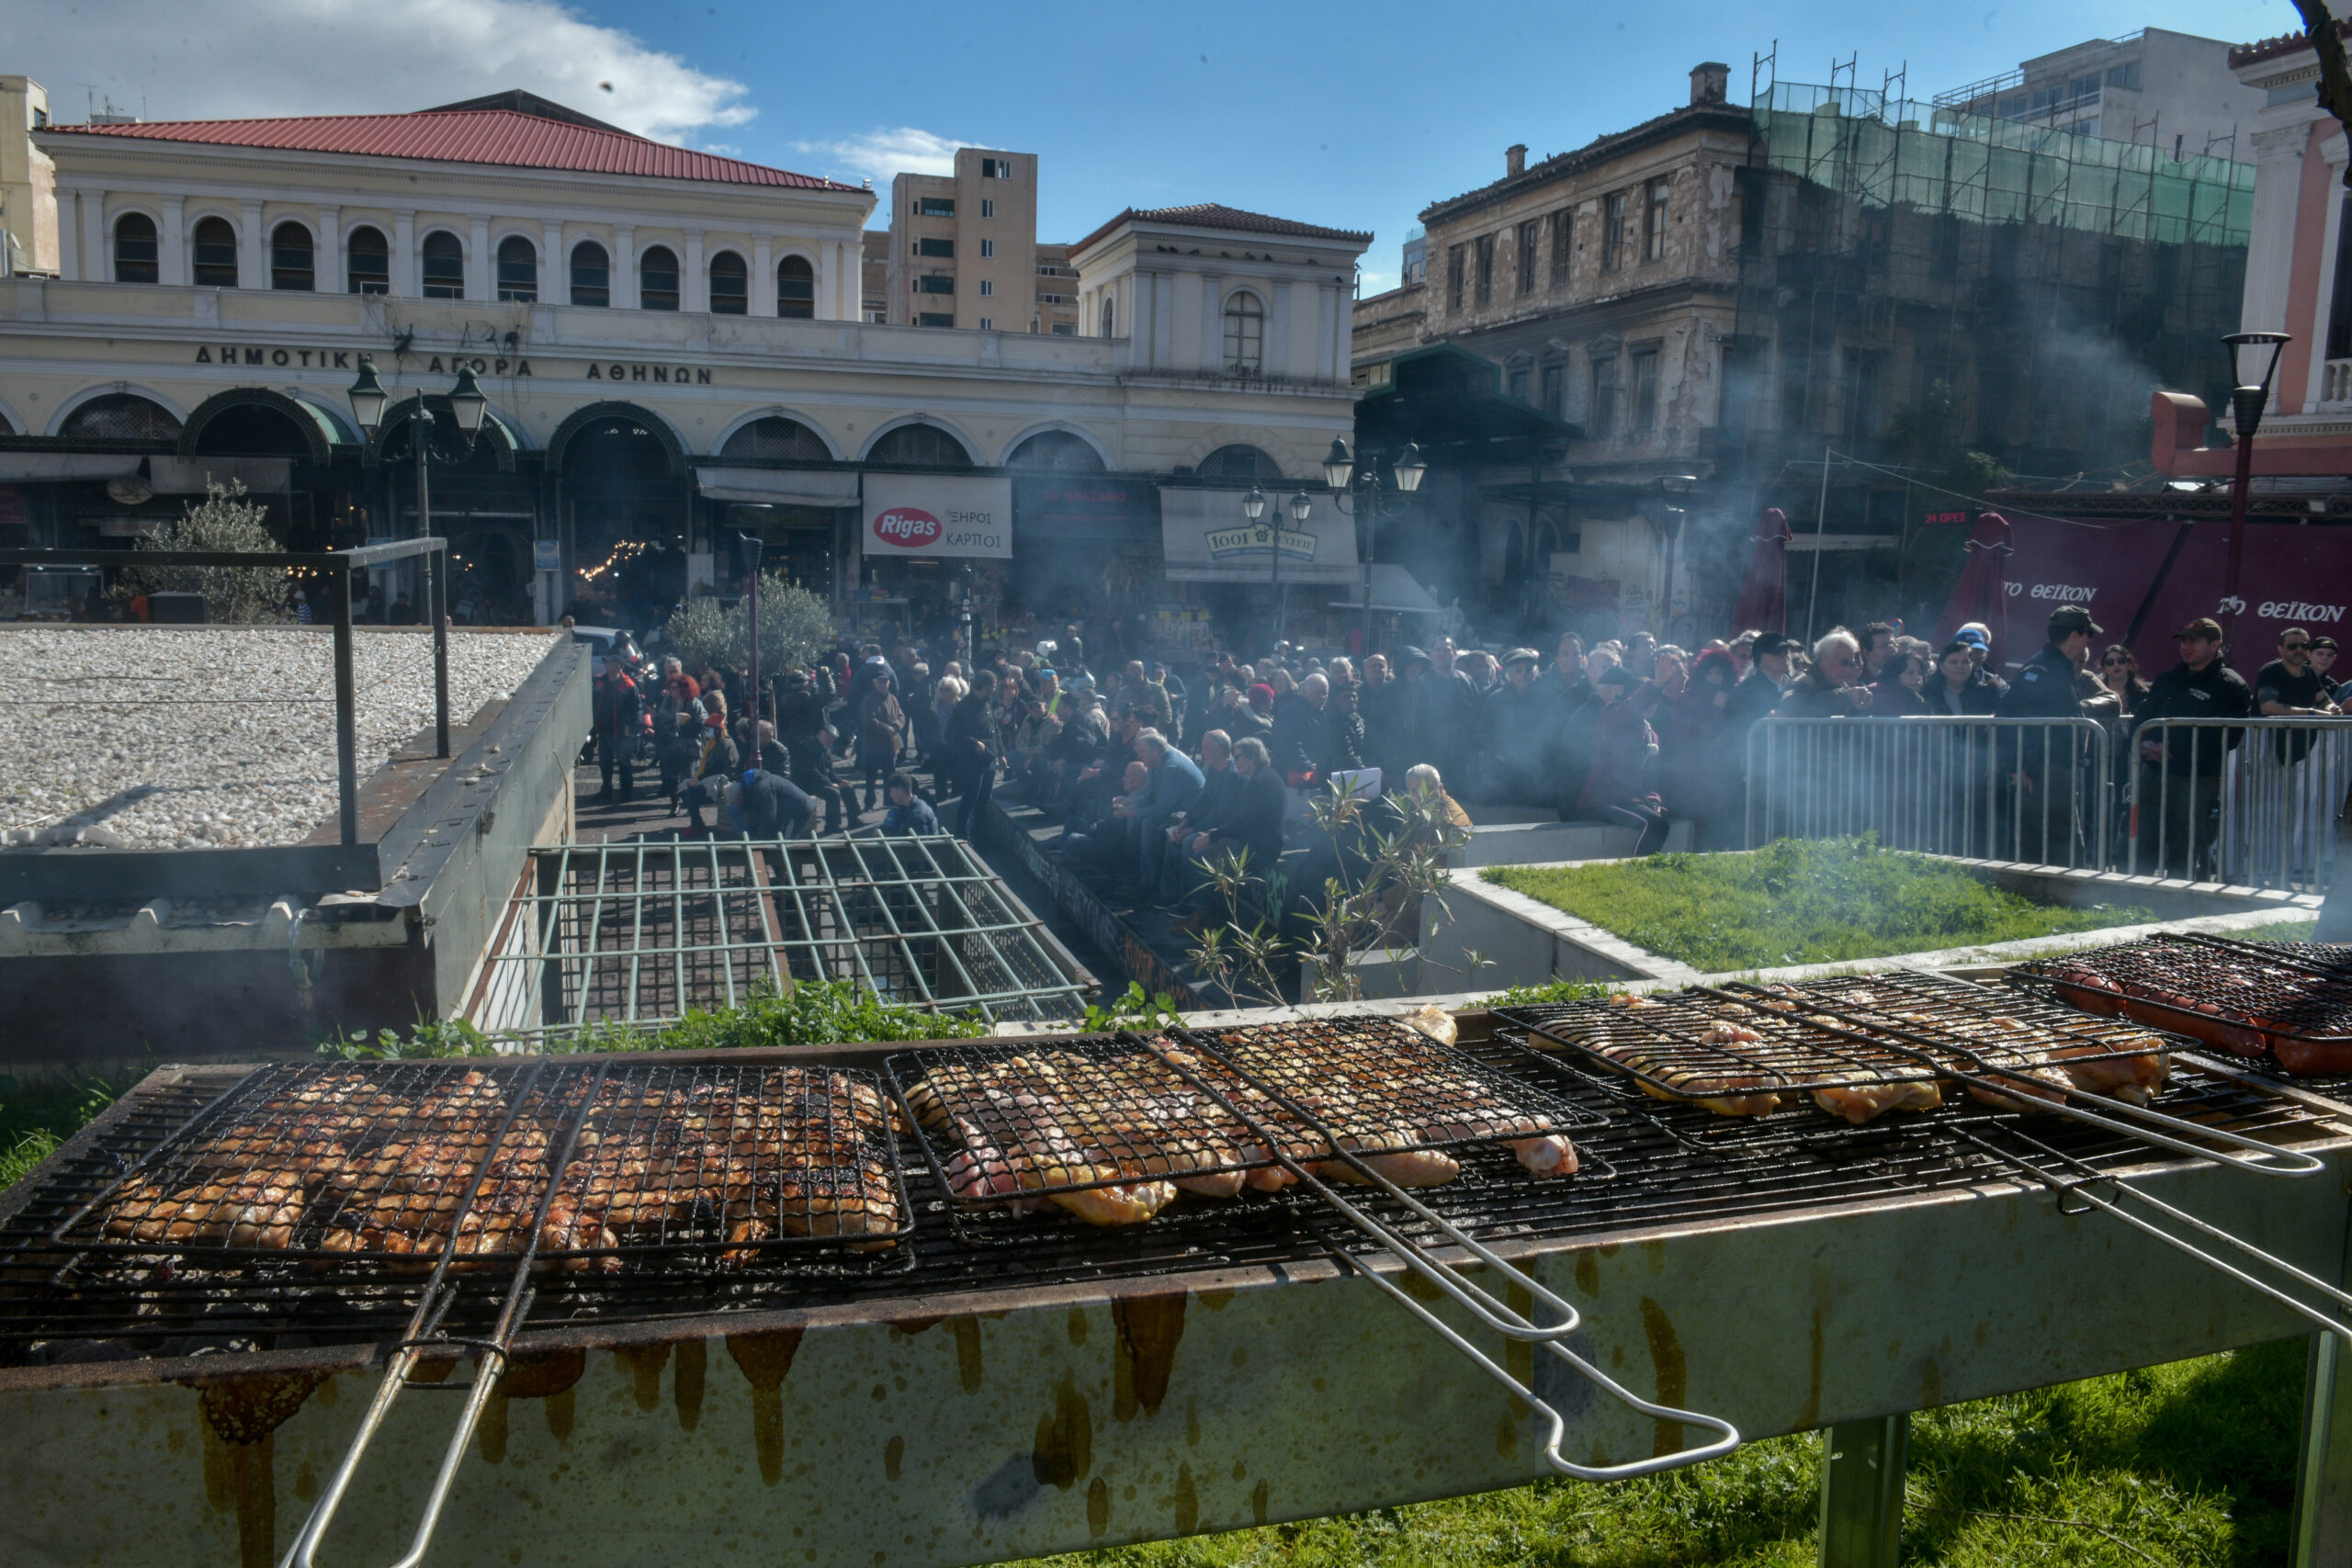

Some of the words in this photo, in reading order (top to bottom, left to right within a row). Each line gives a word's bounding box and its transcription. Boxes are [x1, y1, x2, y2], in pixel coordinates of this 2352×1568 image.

[196, 346, 372, 368] ΔΗΜΟΤΙΚΗ
[428, 356, 532, 377] ΑΓΟΡΑ
[587, 363, 712, 384] ΑΘΗΝΩΝ
[880, 514, 937, 539] Rigas
[950, 511, 991, 525] ΞΗΡΟΙ
[946, 533, 1001, 547] ΚΑΡΠΟΙ
[1212, 532, 1249, 549] 1001
